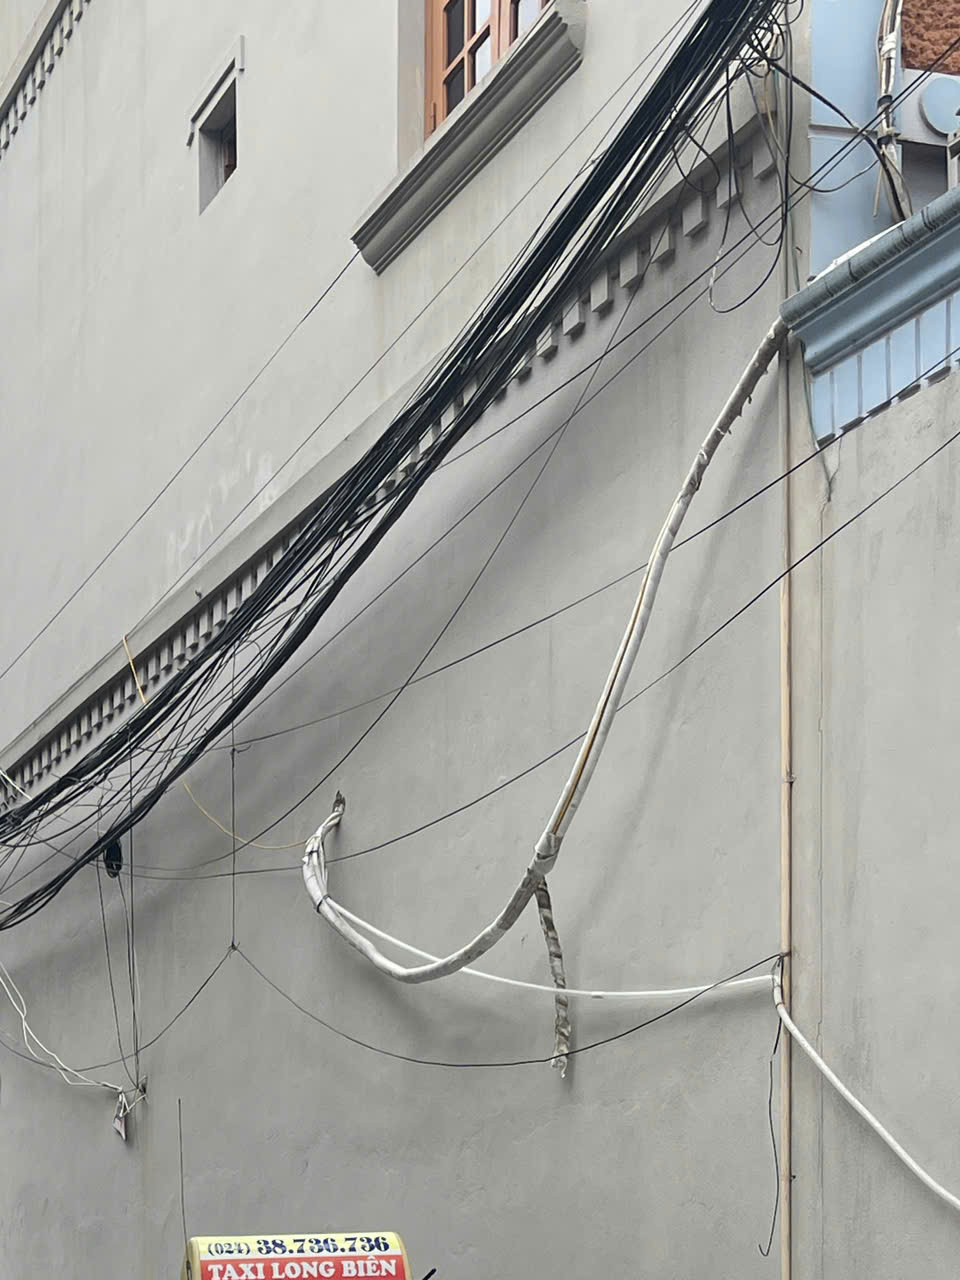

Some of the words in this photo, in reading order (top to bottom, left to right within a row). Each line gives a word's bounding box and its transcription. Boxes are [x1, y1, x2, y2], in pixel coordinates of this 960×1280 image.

[208, 1241, 251, 1256] (024)
[256, 1236, 390, 1255] 38.736.736
[207, 1262, 266, 1280] TAXI
[271, 1260, 336, 1279] LONG
[341, 1255, 396, 1277] BIÊN
